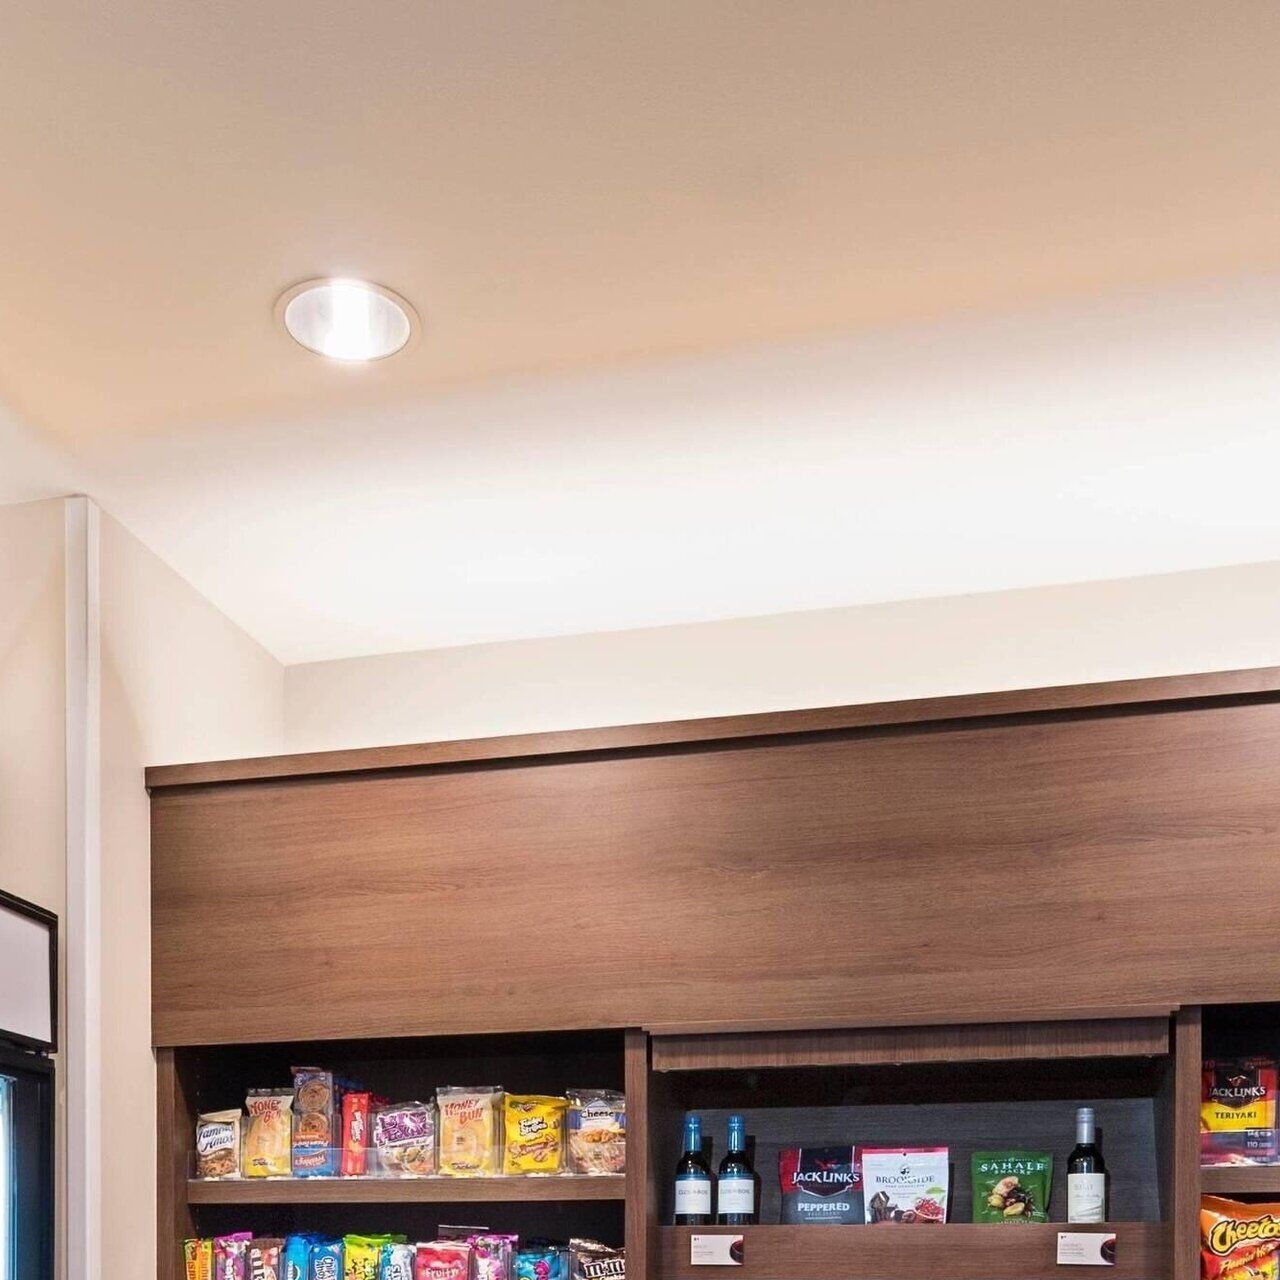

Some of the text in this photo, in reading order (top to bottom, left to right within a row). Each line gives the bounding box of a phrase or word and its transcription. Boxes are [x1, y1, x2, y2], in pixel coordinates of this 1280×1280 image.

[1209, 1087, 1233, 1097] JACK
[459, 1107, 483, 1126] BUN
[580, 1109, 615, 1119] Cheese
[1214, 1111, 1258, 1120] TERIYAKI
[197, 1122, 235, 1142] Famous
[202, 1134, 235, 1151] Amos
[980, 1162, 1046, 1173] SAHALE
[792, 1171, 820, 1185] JACK
[797, 1201, 851, 1212] PEPPERED
